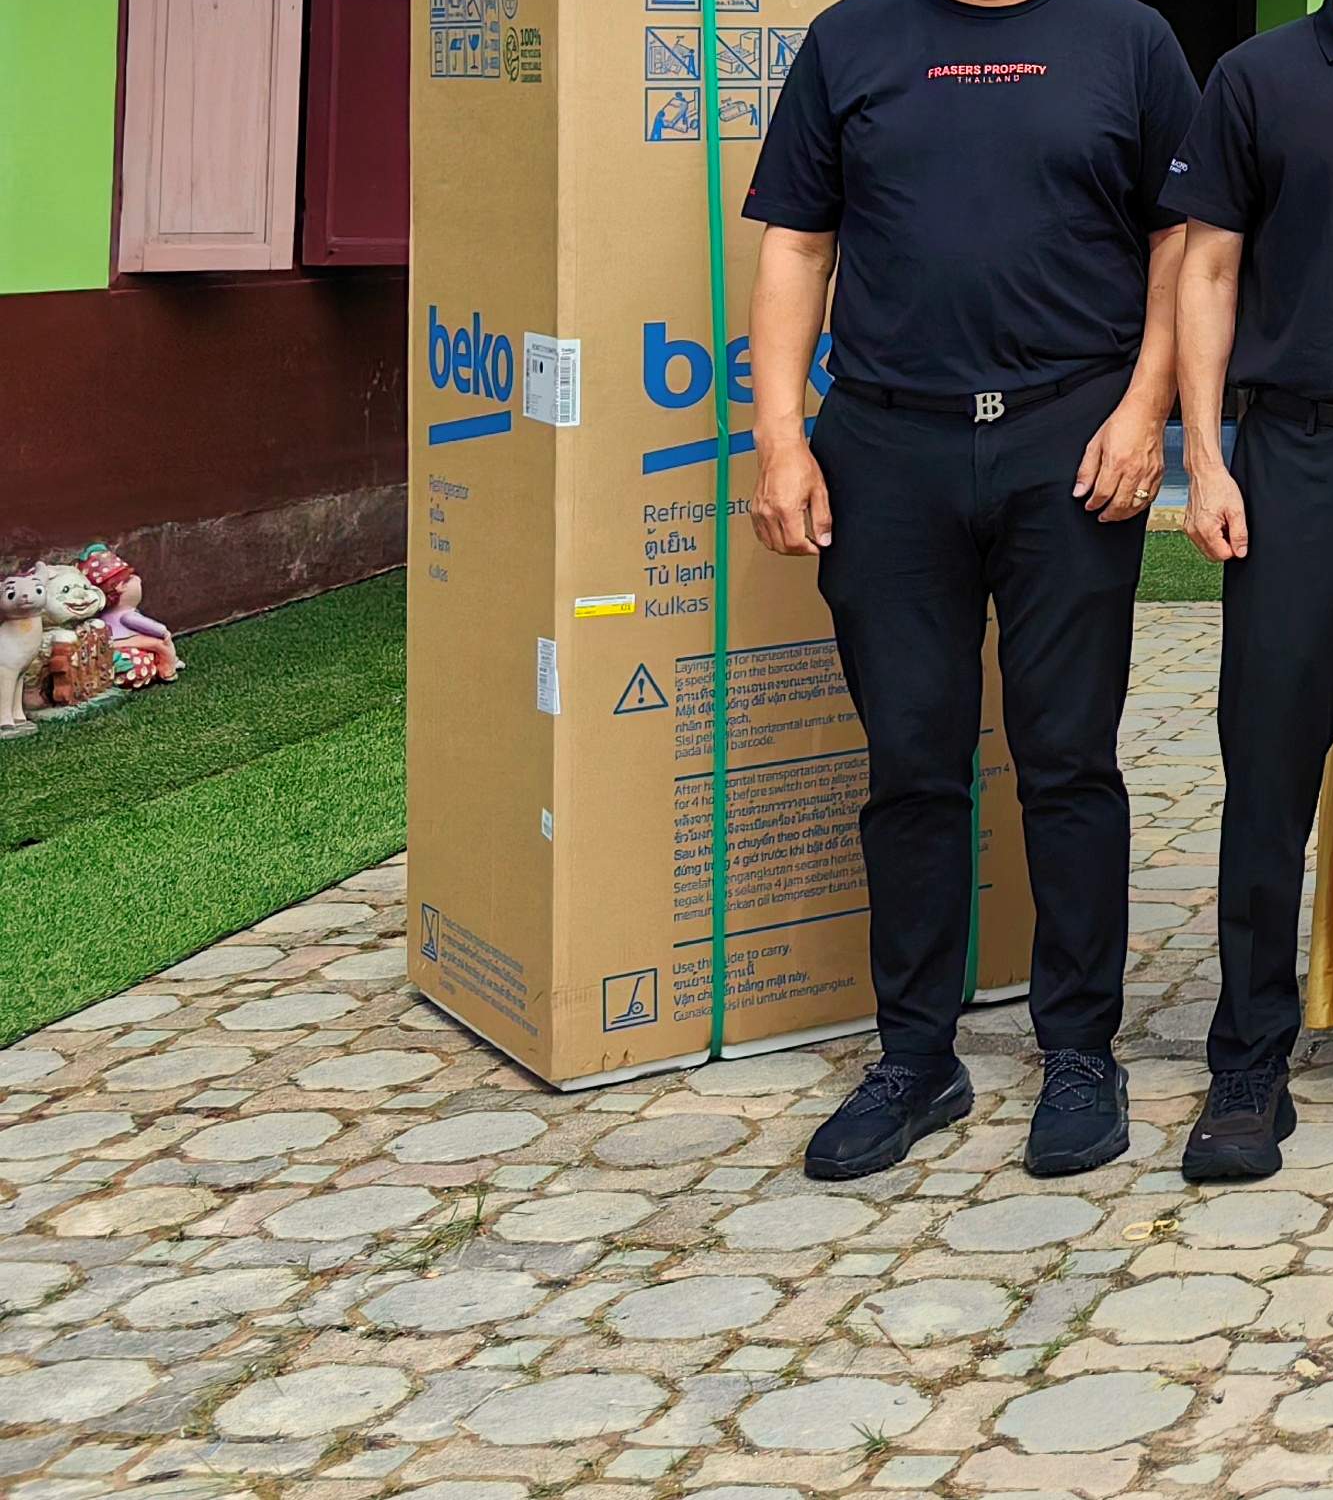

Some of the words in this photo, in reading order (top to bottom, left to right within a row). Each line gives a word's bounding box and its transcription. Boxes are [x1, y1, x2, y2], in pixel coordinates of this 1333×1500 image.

[520, 28, 541, 46] 100%
[928, 65, 981, 78] FRASERS
[984, 63, 1047, 75] PROPERTY
[957, 75, 1020, 84] THAILAND
[429, 305, 513, 402] beko
[643, 498, 752, 523] Refrigeat
[645, 528, 697, 560] ตู้เย็น
[644, 564, 669, 586] Tủ
[676, 560, 715, 587] lạnh
[645, 595, 709, 618] Kulkas
[675, 660, 710, 674] Laying
[734, 654, 750, 666] for
[749, 667, 766, 677] the
[768, 660, 808, 674] barcode
[751, 719, 802, 735] horizontal
[675, 784, 705, 796] After
[834, 758, 868, 772] produc
[674, 799, 690, 810] for
[733, 786, 768, 801] before
[803, 779, 818, 789] on
[818, 777, 831, 787] to
[778, 830, 799, 842] theo
[733, 856, 740, 865] 4
[673, 962, 695, 975] Use
[725, 952, 744, 964] ide
[747, 949, 759, 960] to
[761, 943, 792, 957] carry.
[674, 1006, 713, 1022] Gunaka
[756, 990, 787, 1006] untuk
